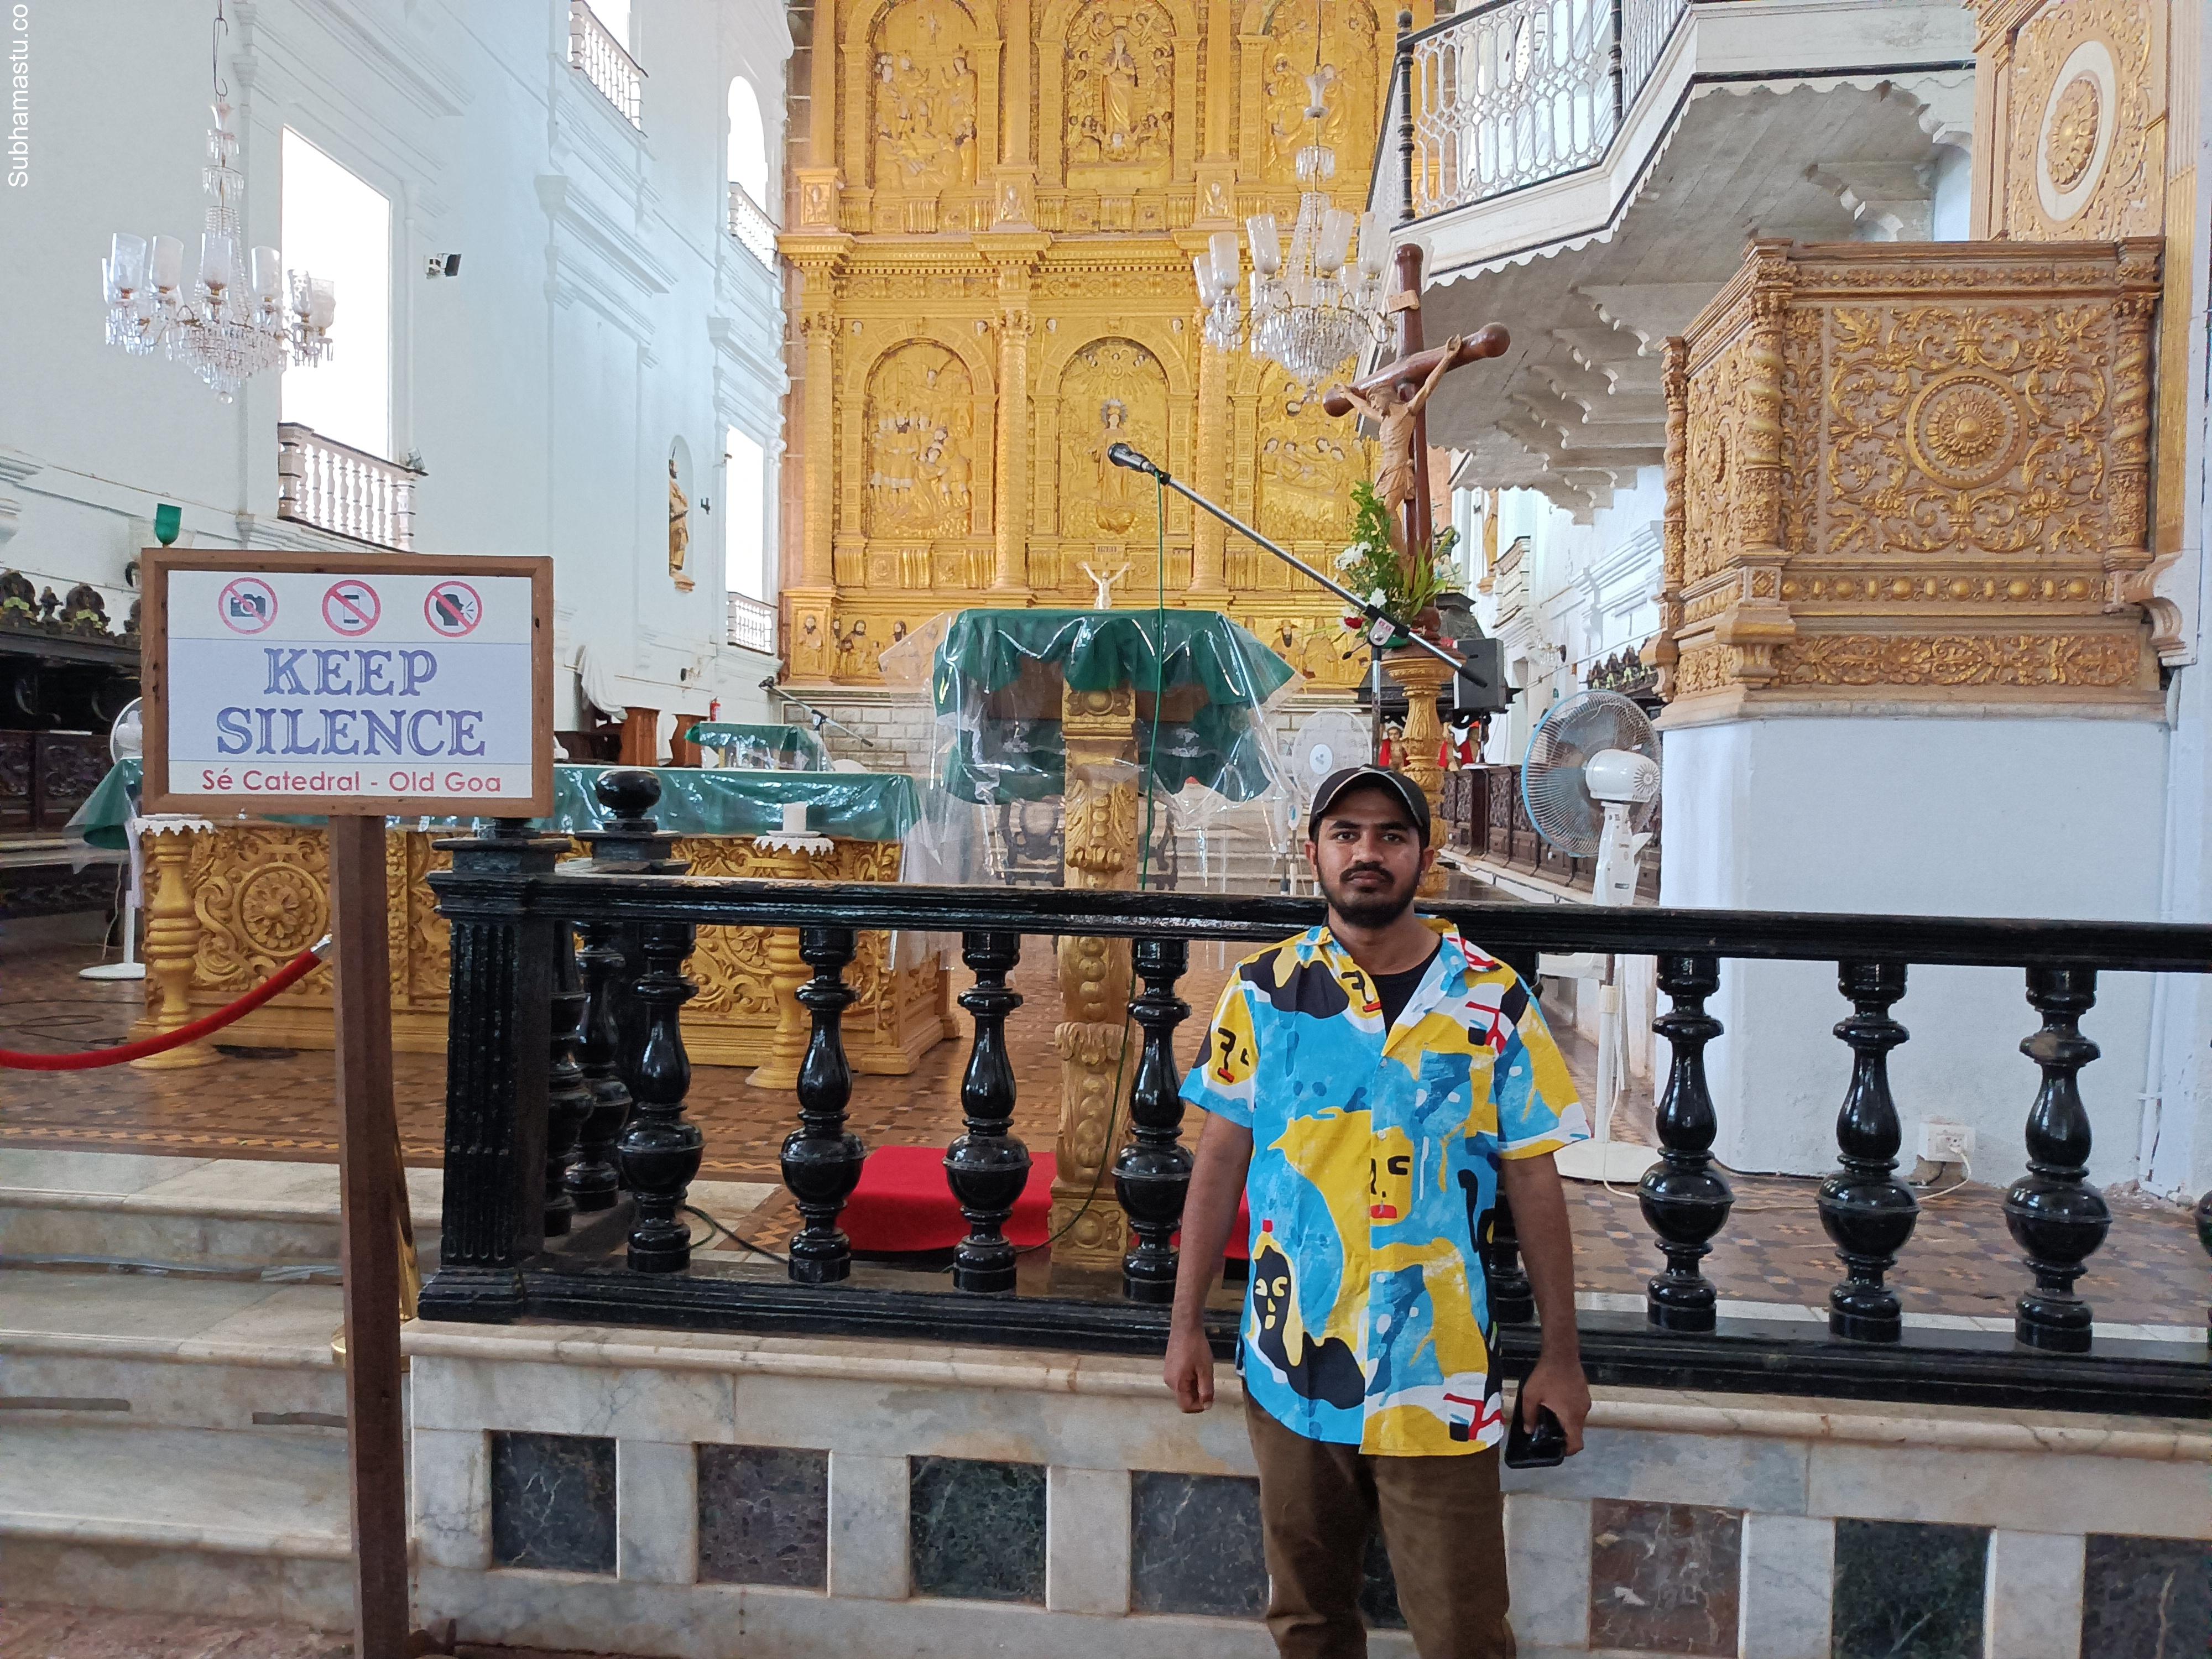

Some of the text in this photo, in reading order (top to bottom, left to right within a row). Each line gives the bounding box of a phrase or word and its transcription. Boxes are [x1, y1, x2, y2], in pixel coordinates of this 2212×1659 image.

[264, 648, 437, 696] KEEP
[217, 707, 486, 756] SILENCE
[202, 768, 233, 791] Sé
[243, 770, 359, 791] Catedral
[389, 771, 434, 792] Old
[445, 773, 501, 792] Goa
